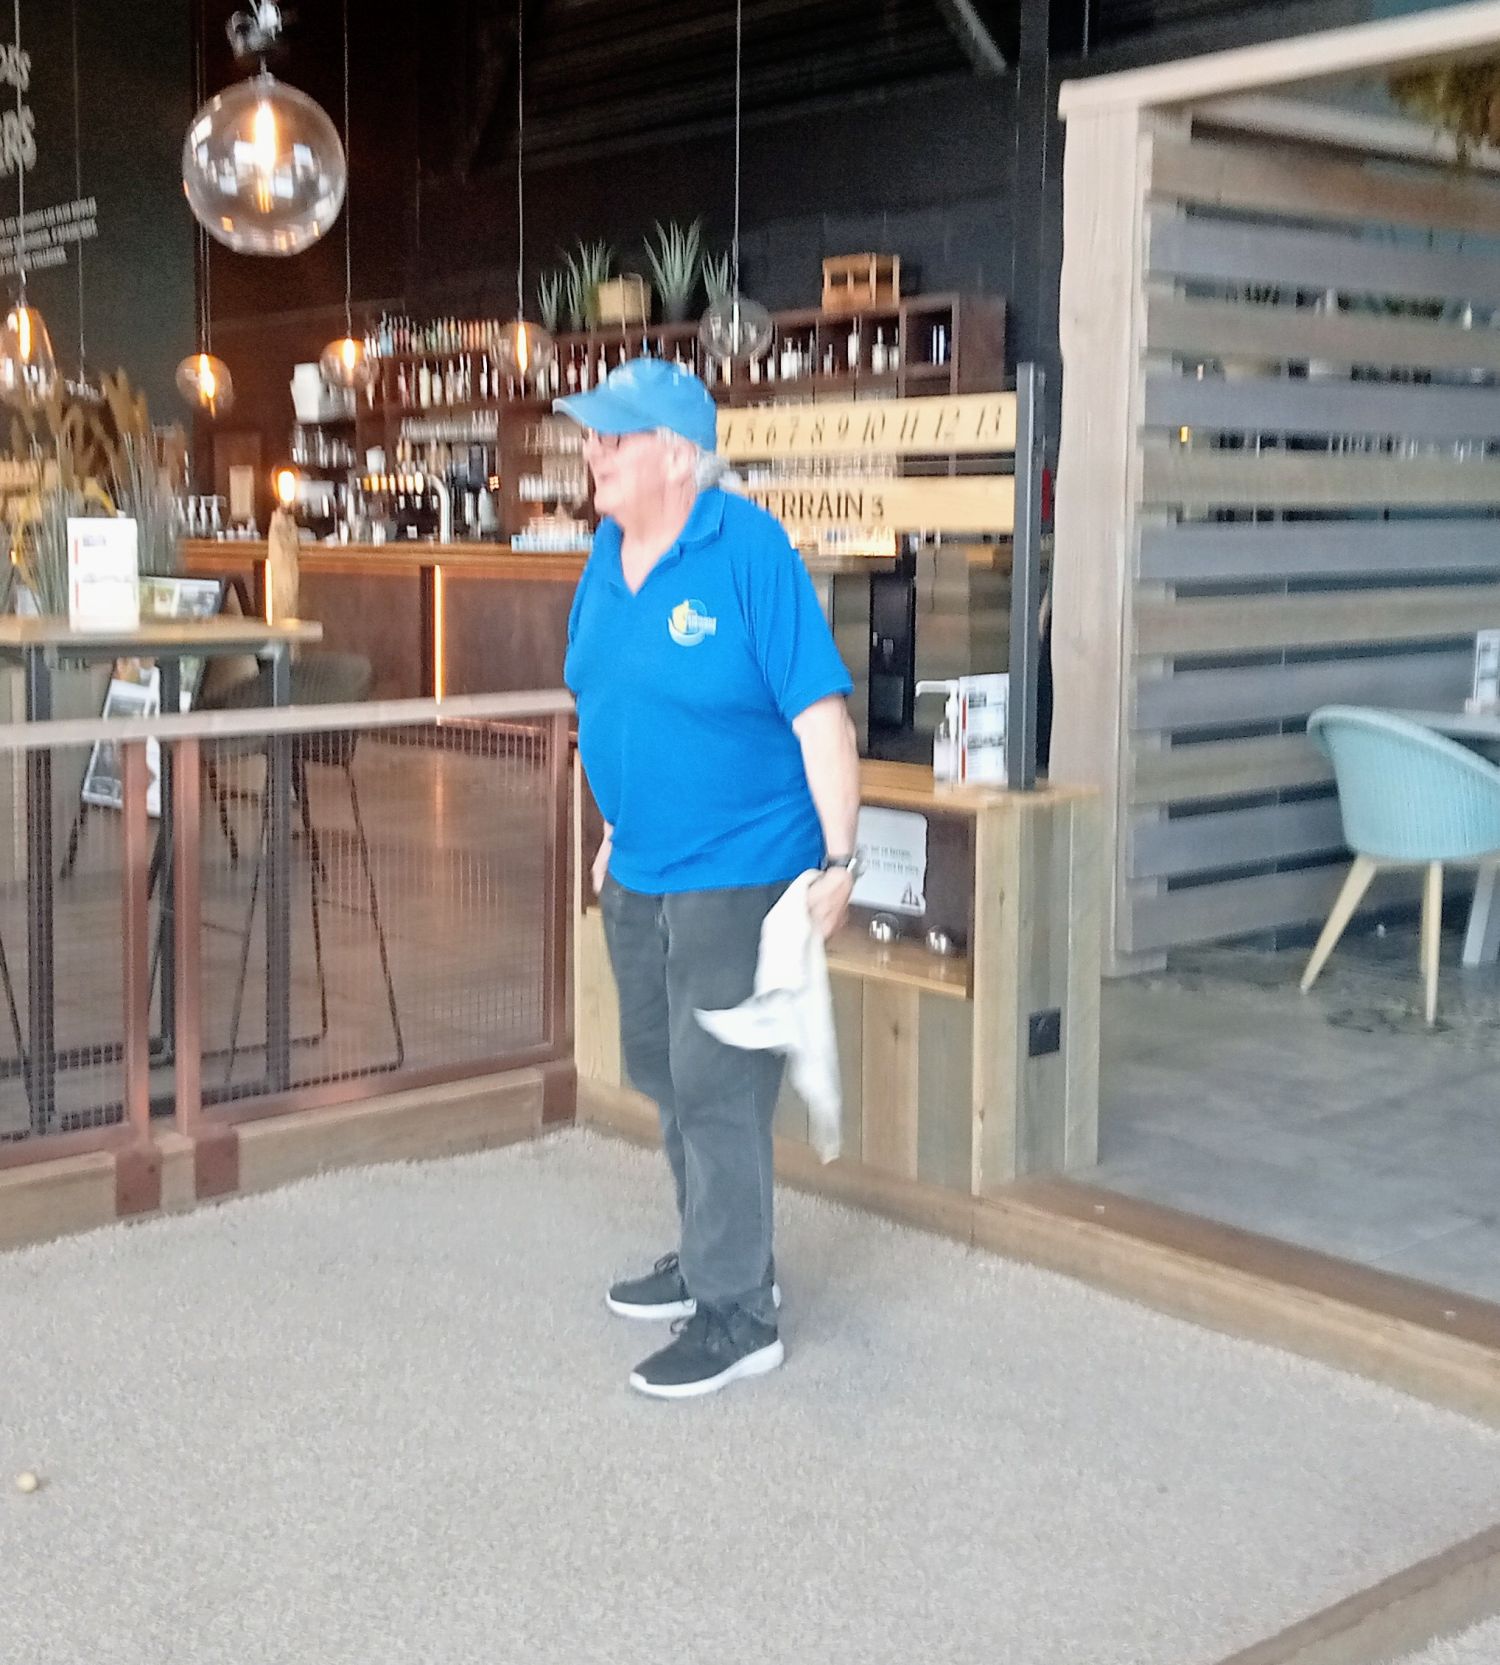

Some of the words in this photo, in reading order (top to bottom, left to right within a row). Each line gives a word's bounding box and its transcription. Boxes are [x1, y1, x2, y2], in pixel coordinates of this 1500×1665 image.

[765, 417, 777, 449] 6
[810, 411, 826, 446] 8
[837, 410, 850, 440] 9
[862, 408, 886, 445] 10
[900, 408, 920, 443] 11
[935, 407, 961, 444] 12
[976, 404, 1002, 439] 13
[749, 488, 863, 520] TERRAIN
[871, 494, 885, 518] 3
